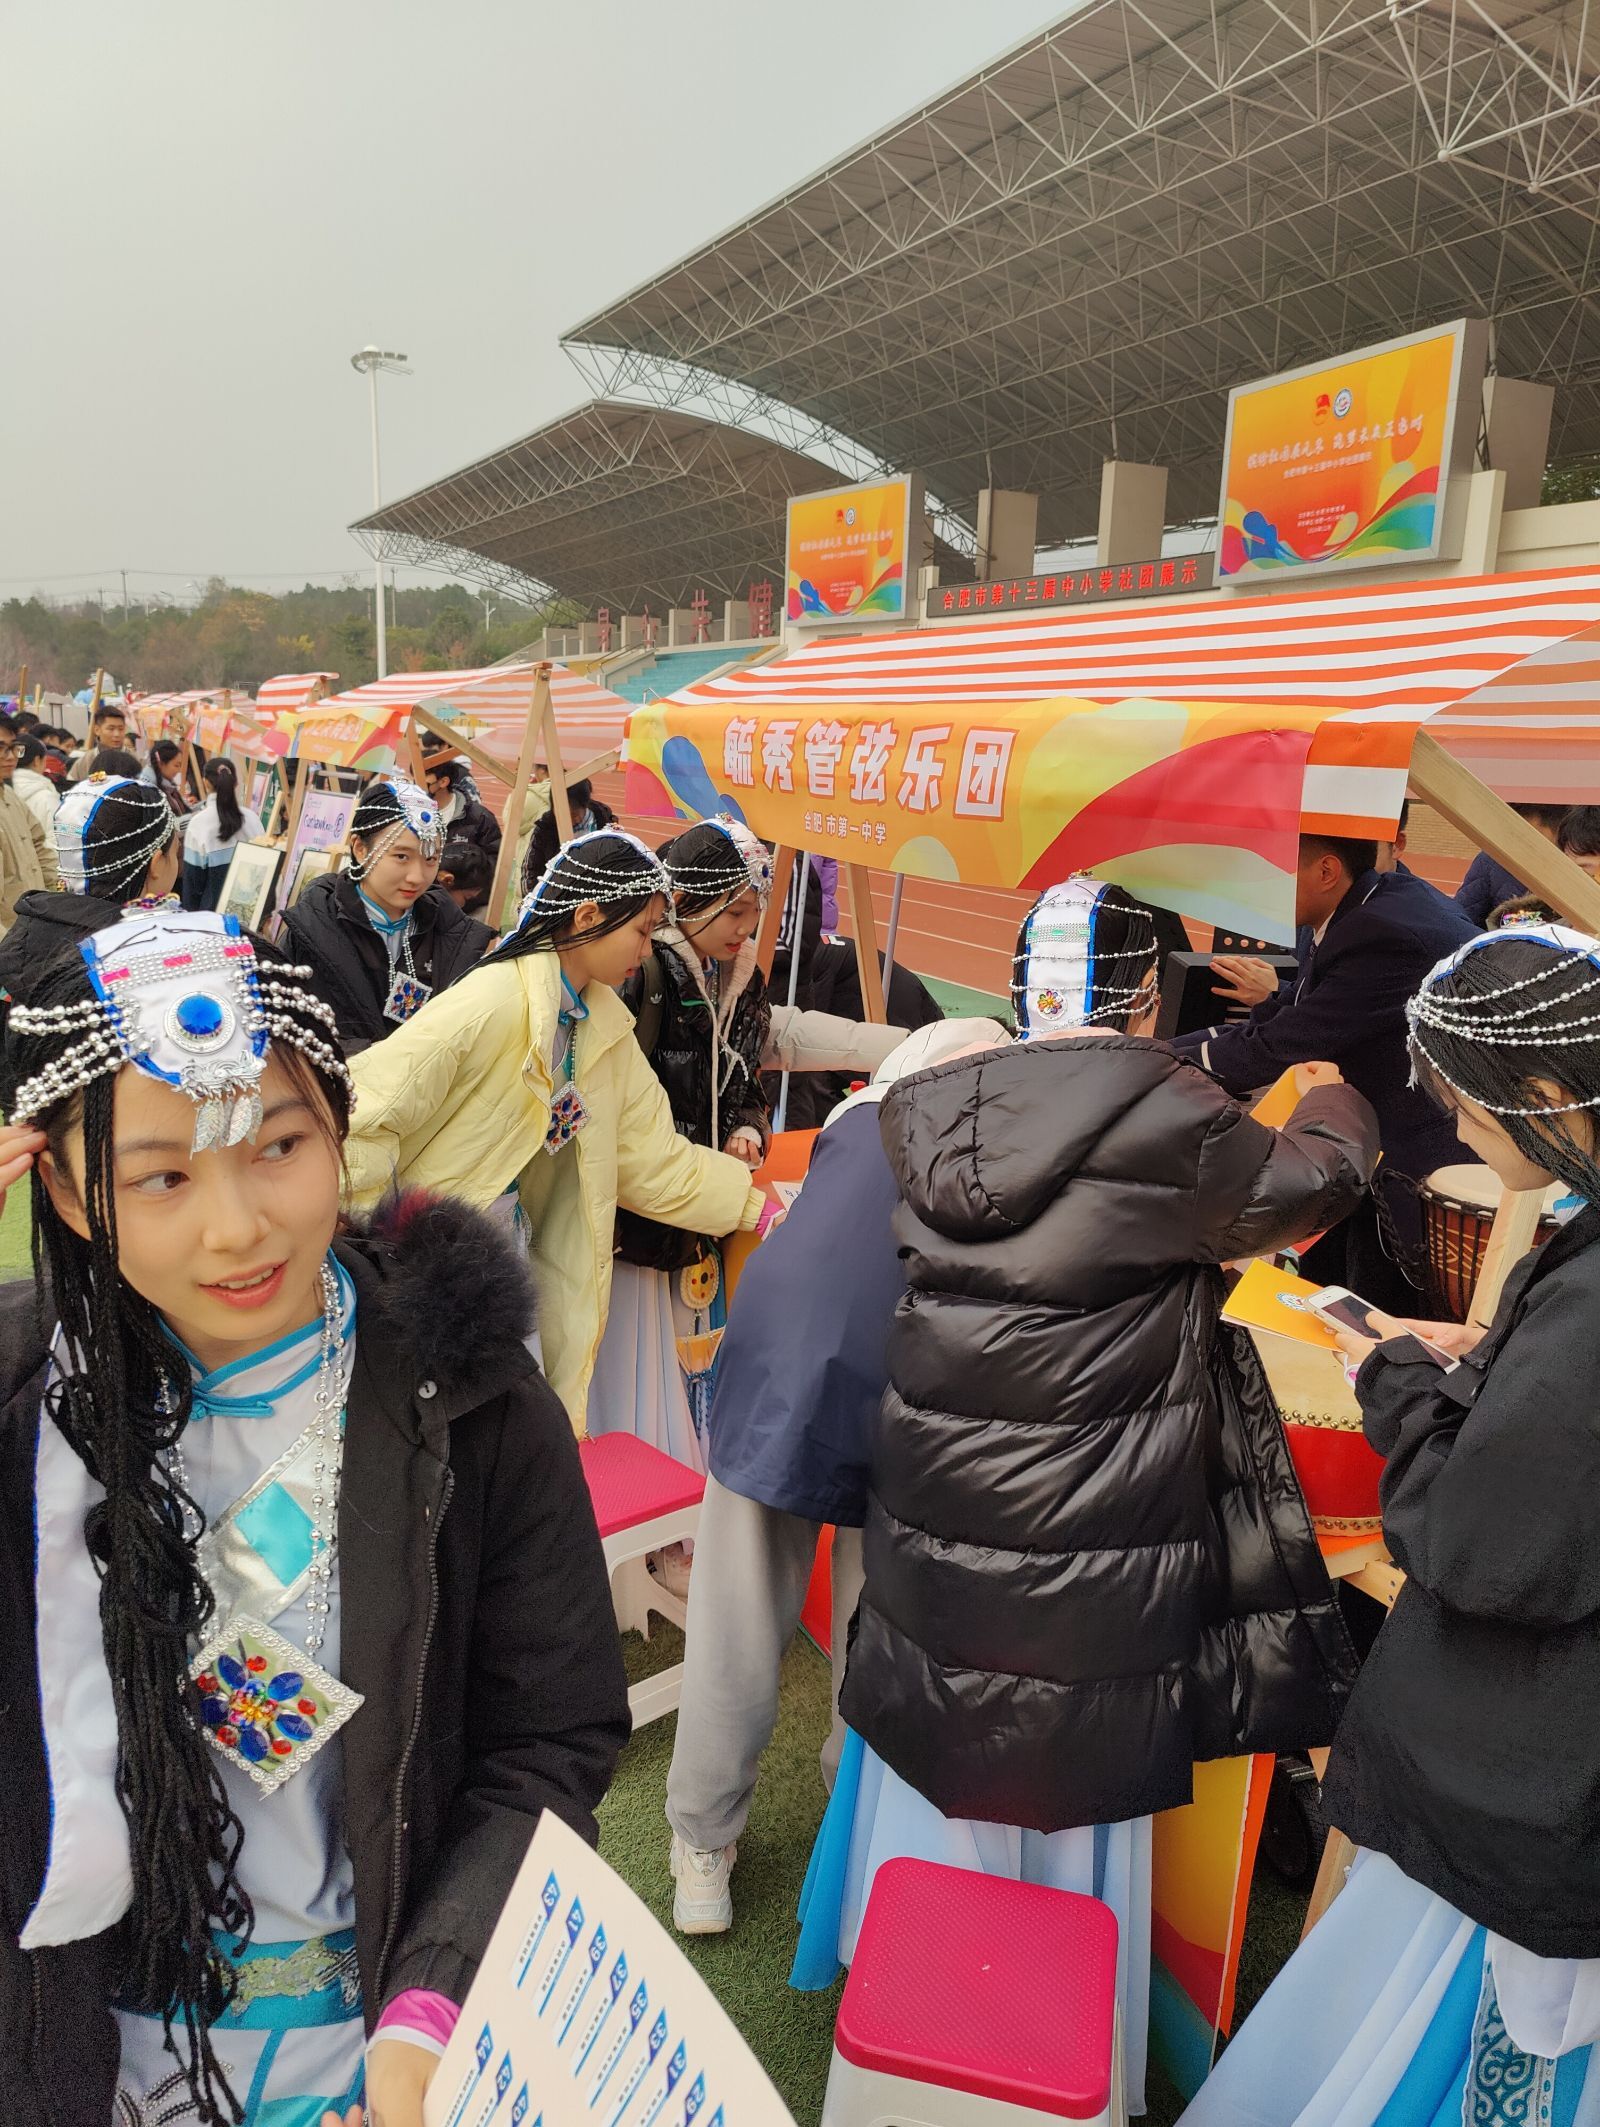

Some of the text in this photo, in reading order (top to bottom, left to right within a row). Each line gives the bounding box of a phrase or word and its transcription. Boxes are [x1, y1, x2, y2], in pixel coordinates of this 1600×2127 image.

[943, 559, 1198, 610] 合肥市第十三届中小学社团展示
[723, 714, 1020, 822] 毓秀管弦乐团
[803, 811, 888, 846] 合肥市第一中学
[543, 1882, 559, 1907] 43
[567, 1908, 584, 1931] 41
[590, 1935, 607, 1961] 39
[612, 1963, 628, 1992] 37
[630, 1991, 648, 2021] 35
[649, 2021, 667, 2049] 33
[668, 2052, 687, 2080] 31
[513, 2095, 528, 2122] 40
[686, 2085, 705, 2115] 29
